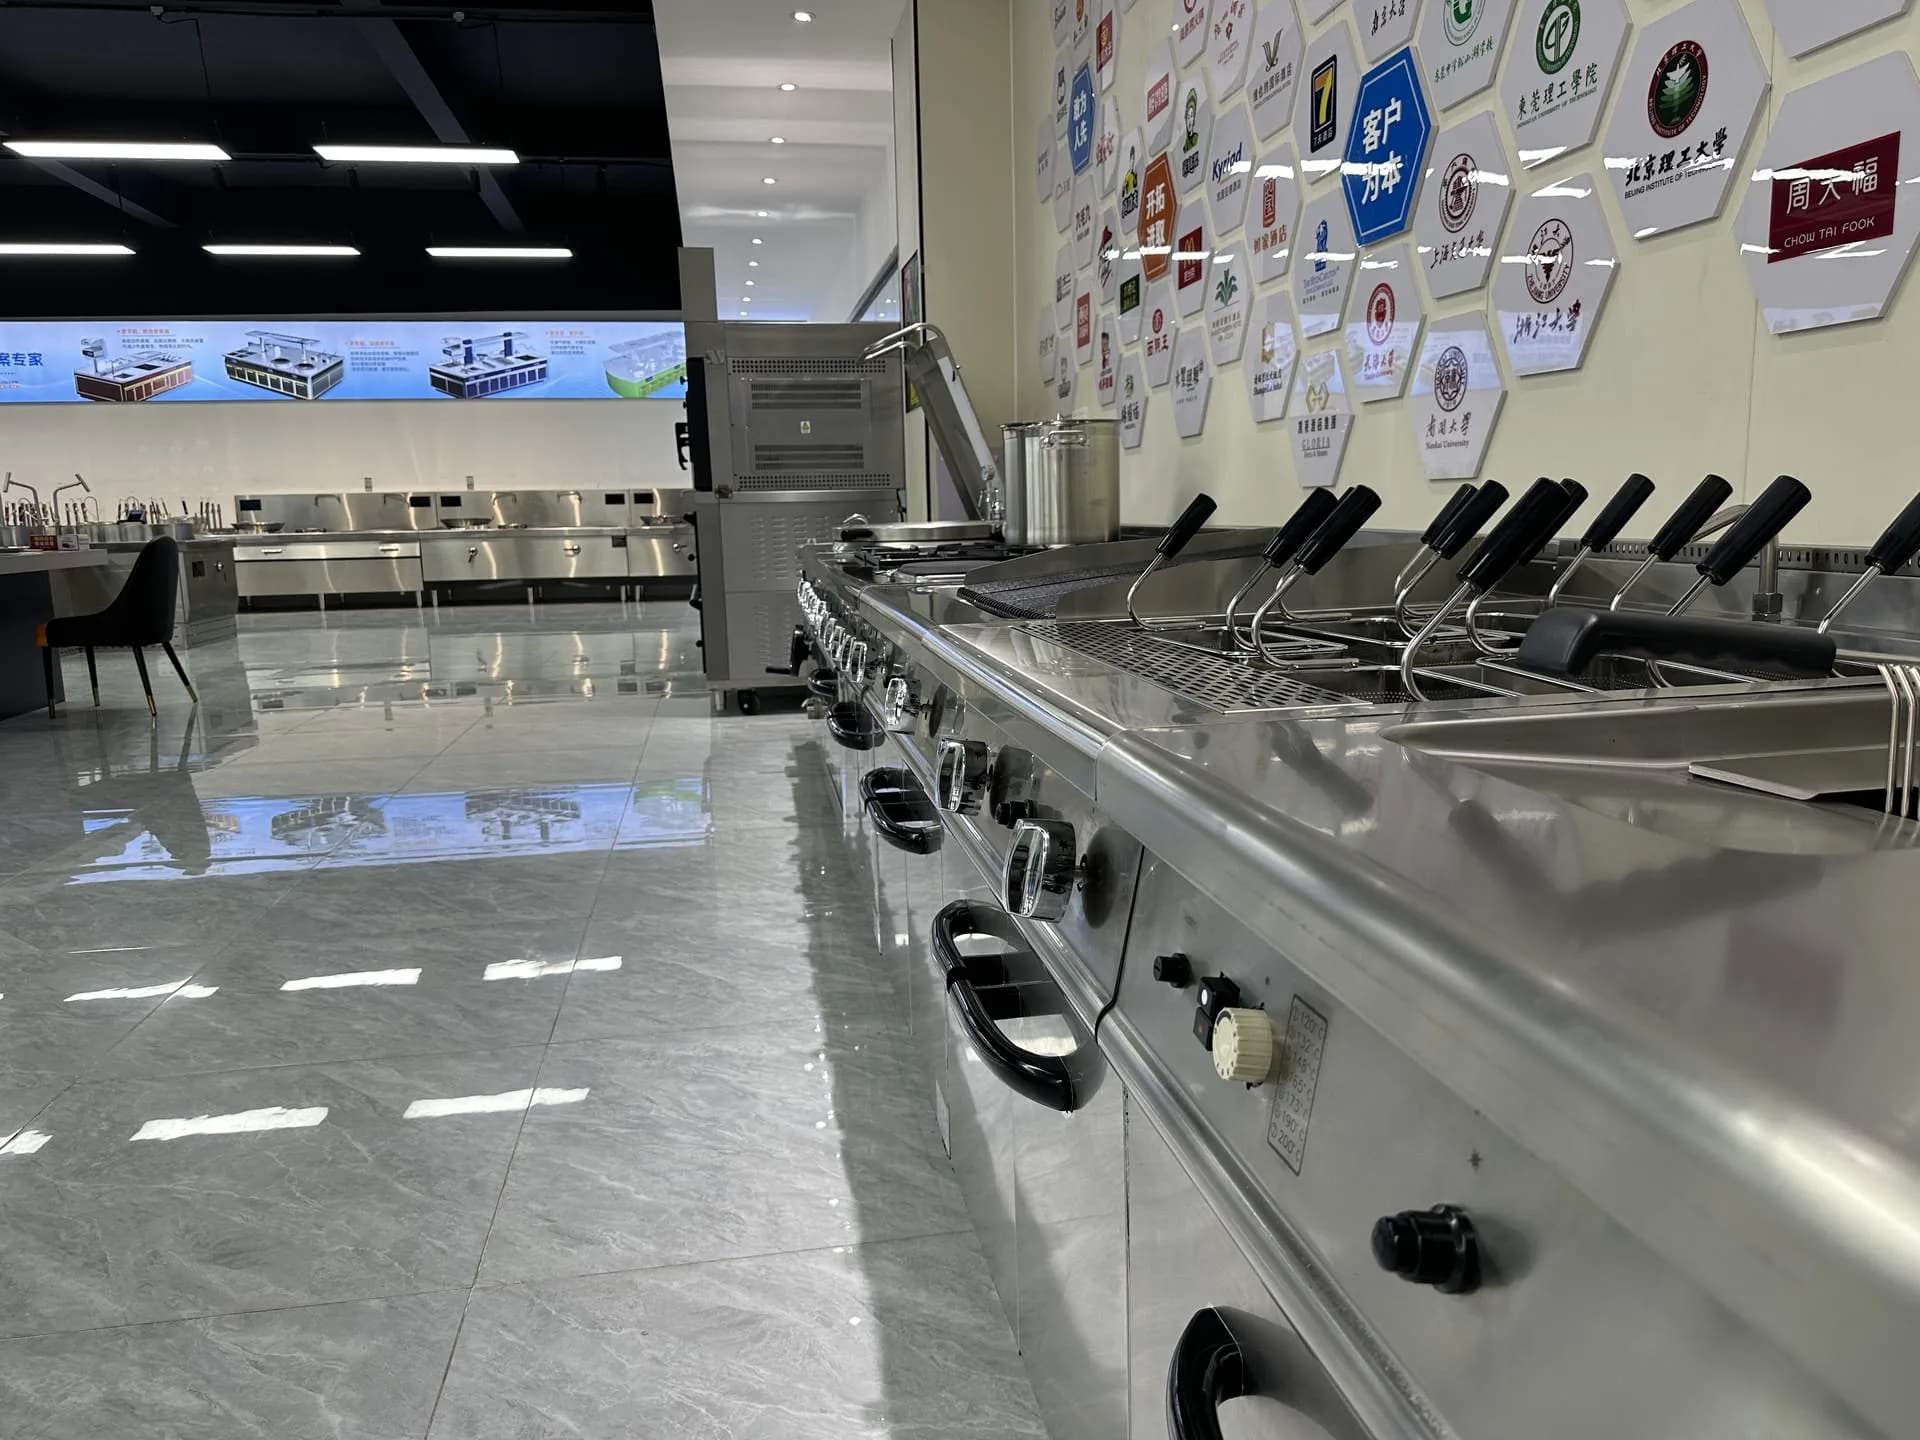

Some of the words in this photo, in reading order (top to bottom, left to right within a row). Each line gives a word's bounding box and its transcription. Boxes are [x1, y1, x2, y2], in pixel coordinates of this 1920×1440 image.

[1363, 97, 1401, 154] 客户
[1212, 142, 1242, 184] Kyriad
[1362, 151, 1404, 204] 为本
[1624, 186, 1645, 199] BEIJING
[1646, 175, 1674, 191] INSTITUTE
[1674, 171, 1683, 181] OF
[1786, 156, 1880, 214] 周大福
[1784, 231, 1815, 248] CHOW
[1819, 226, 1837, 243] TAI
[1842, 216, 1875, 235] FOOK
[1443, 439, 1470, 449] University
